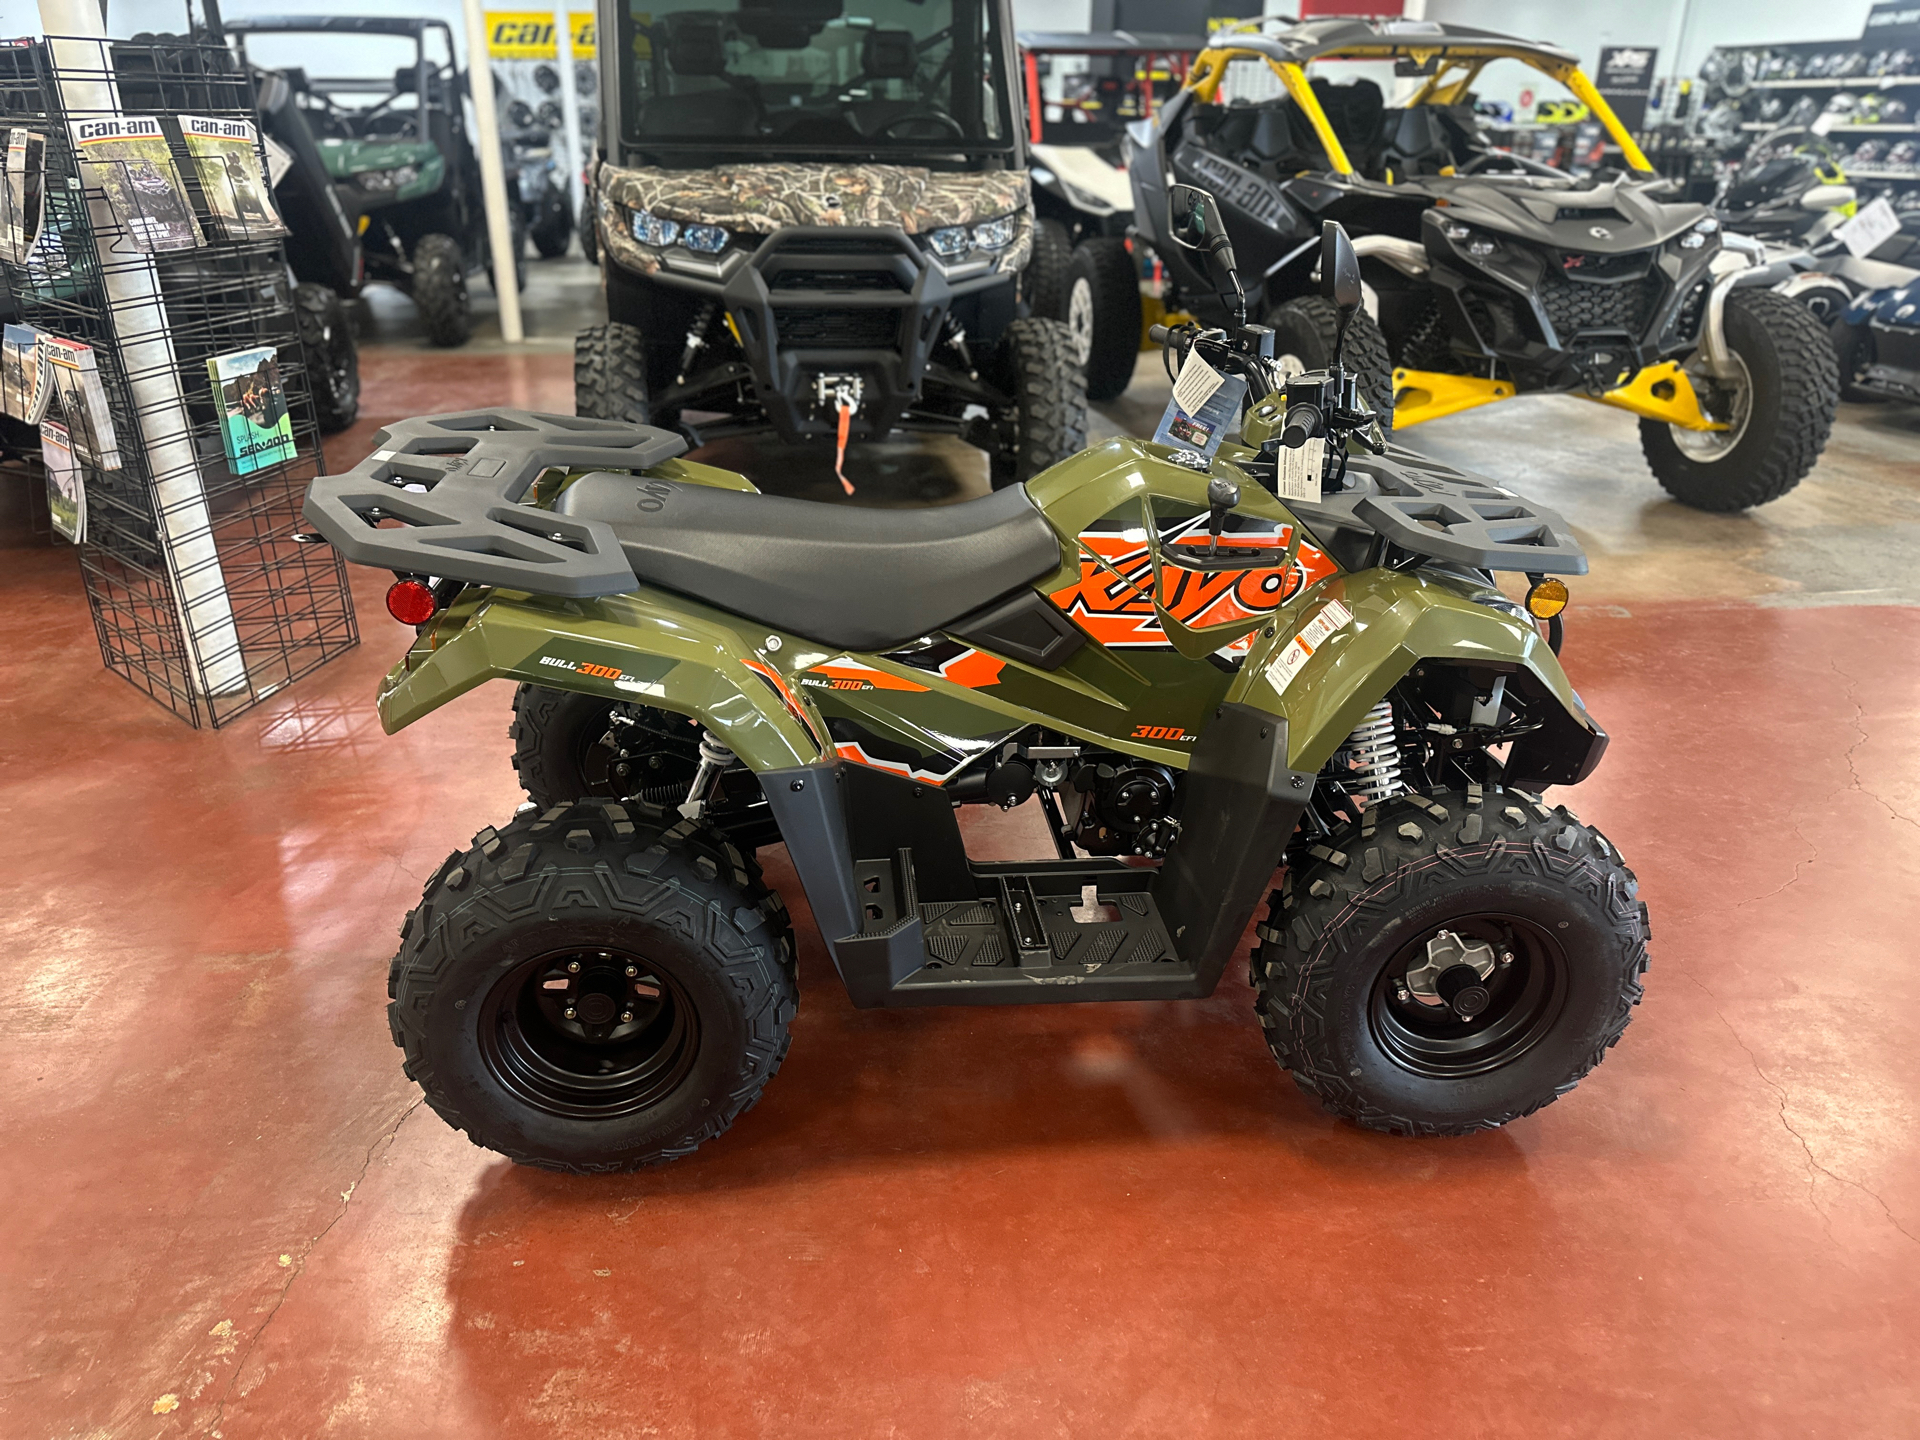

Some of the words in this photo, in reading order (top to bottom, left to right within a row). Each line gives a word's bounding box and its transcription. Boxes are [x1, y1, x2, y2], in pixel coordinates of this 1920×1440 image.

[79, 119, 157, 139] can-am
[190, 118, 246, 138] can-am
[46, 342, 77, 363] can-am
[539, 656, 577, 671] BULL
[800, 678, 829, 688] BULL
